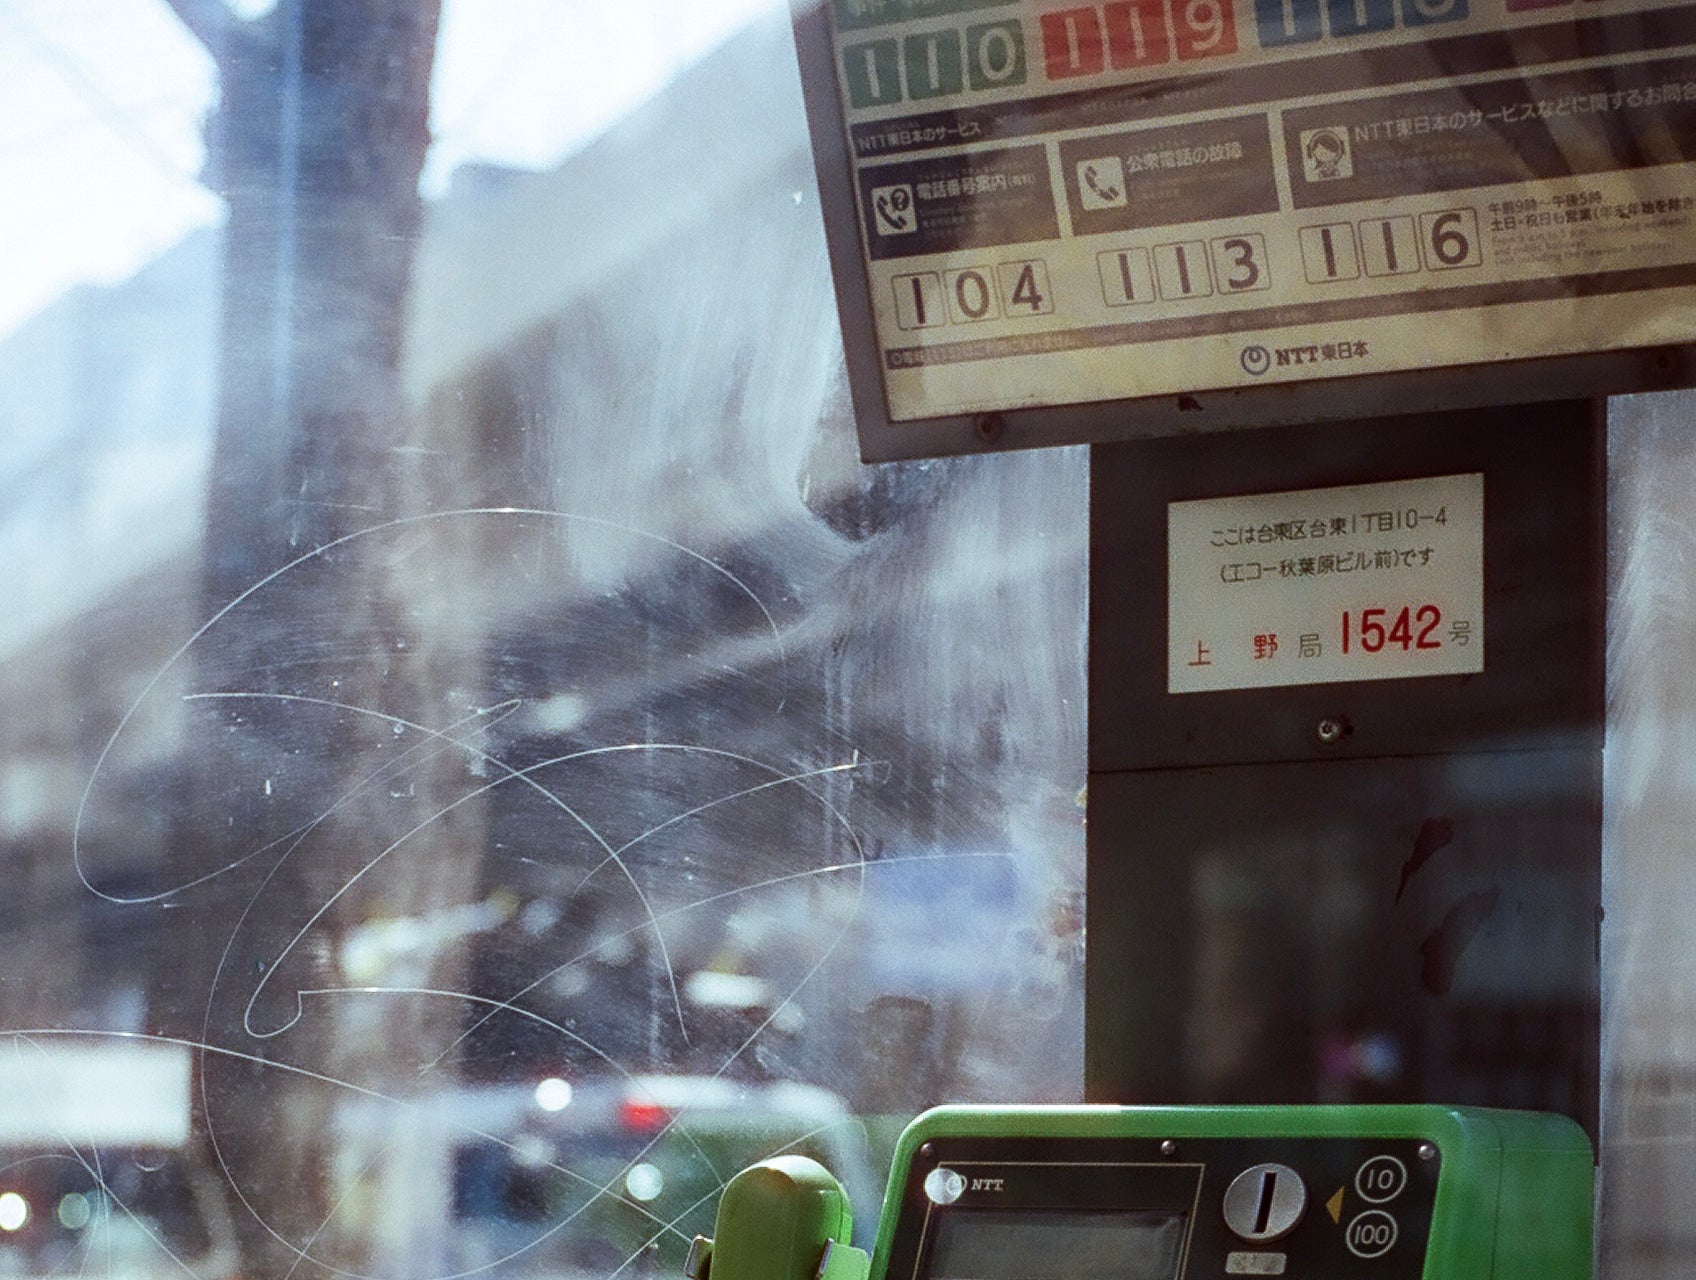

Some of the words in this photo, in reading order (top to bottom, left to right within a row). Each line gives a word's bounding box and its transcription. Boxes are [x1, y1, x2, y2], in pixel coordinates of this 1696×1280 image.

[865, 27, 1016, 98] 110
[1066, 0, 1223, 68] 119
[912, 263, 1043, 324] 104
[1118, 239, 1259, 300] 113
[1320, 212, 1469, 277] 116
[1275, 341, 1369, 366] NTT東日本
[1188, 640, 1211, 666] 上
[1254, 633, 1278, 660] 野
[1342, 605, 1441, 655] 1542
[971, 1178, 1004, 1191] NTT
[1367, 1169, 1394, 1189] 10
[1354, 1224, 1389, 1245] 100
